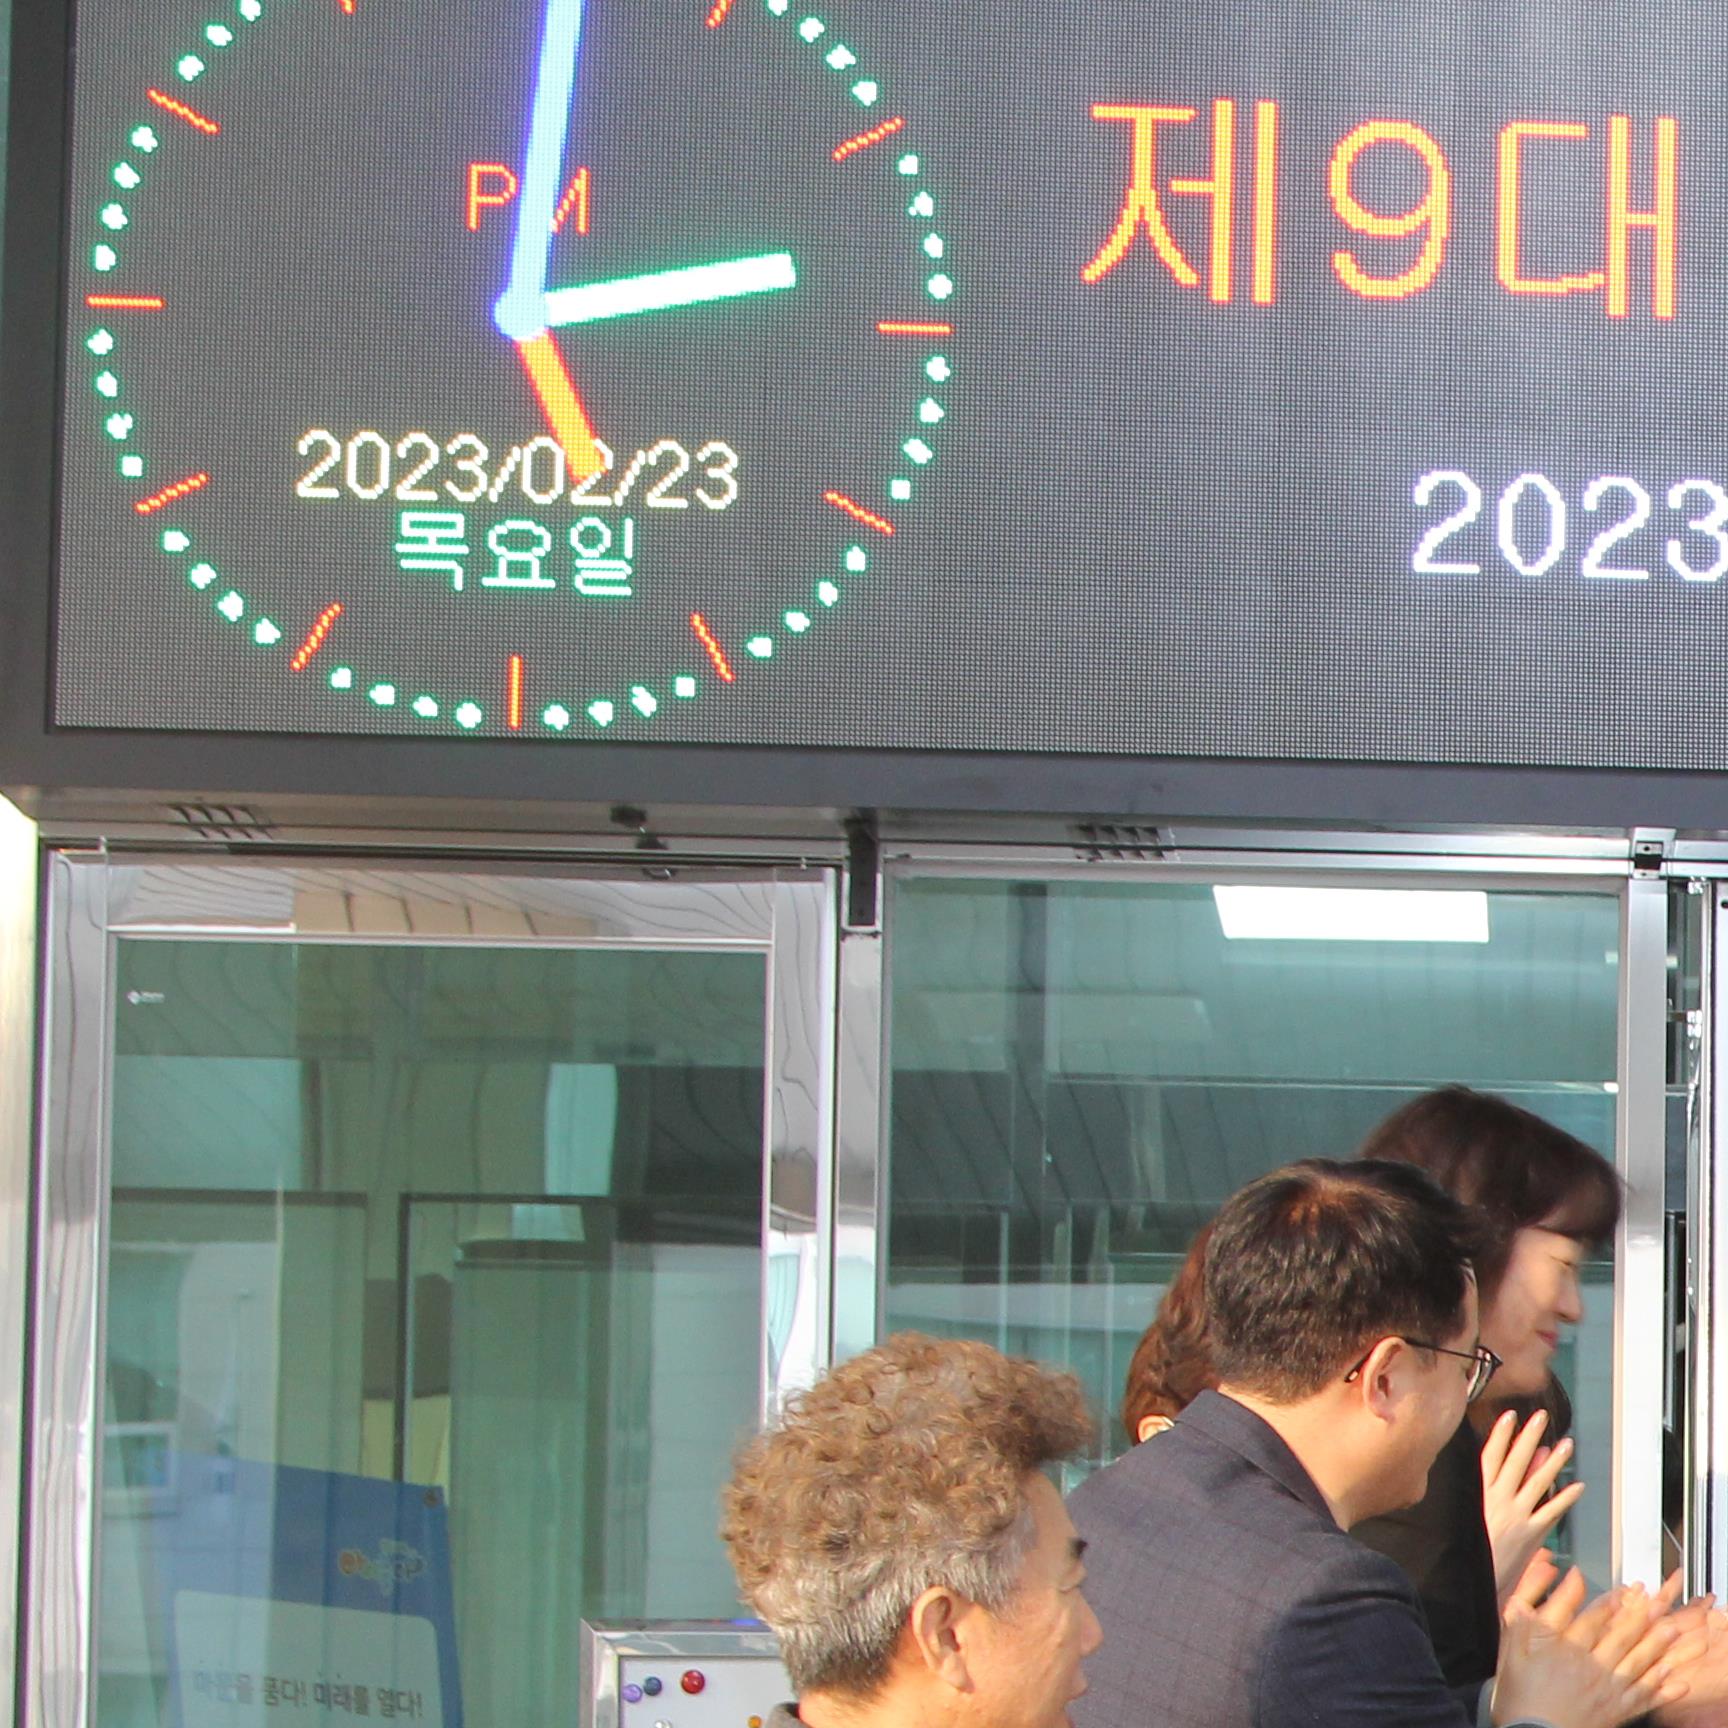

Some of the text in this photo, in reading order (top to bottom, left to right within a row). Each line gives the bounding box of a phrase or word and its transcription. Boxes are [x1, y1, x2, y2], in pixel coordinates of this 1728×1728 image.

[1080, 97, 1680, 322] 제9대
[297, 429, 739, 509] 2023/02/23
[395, 512, 634, 597] 목요일
